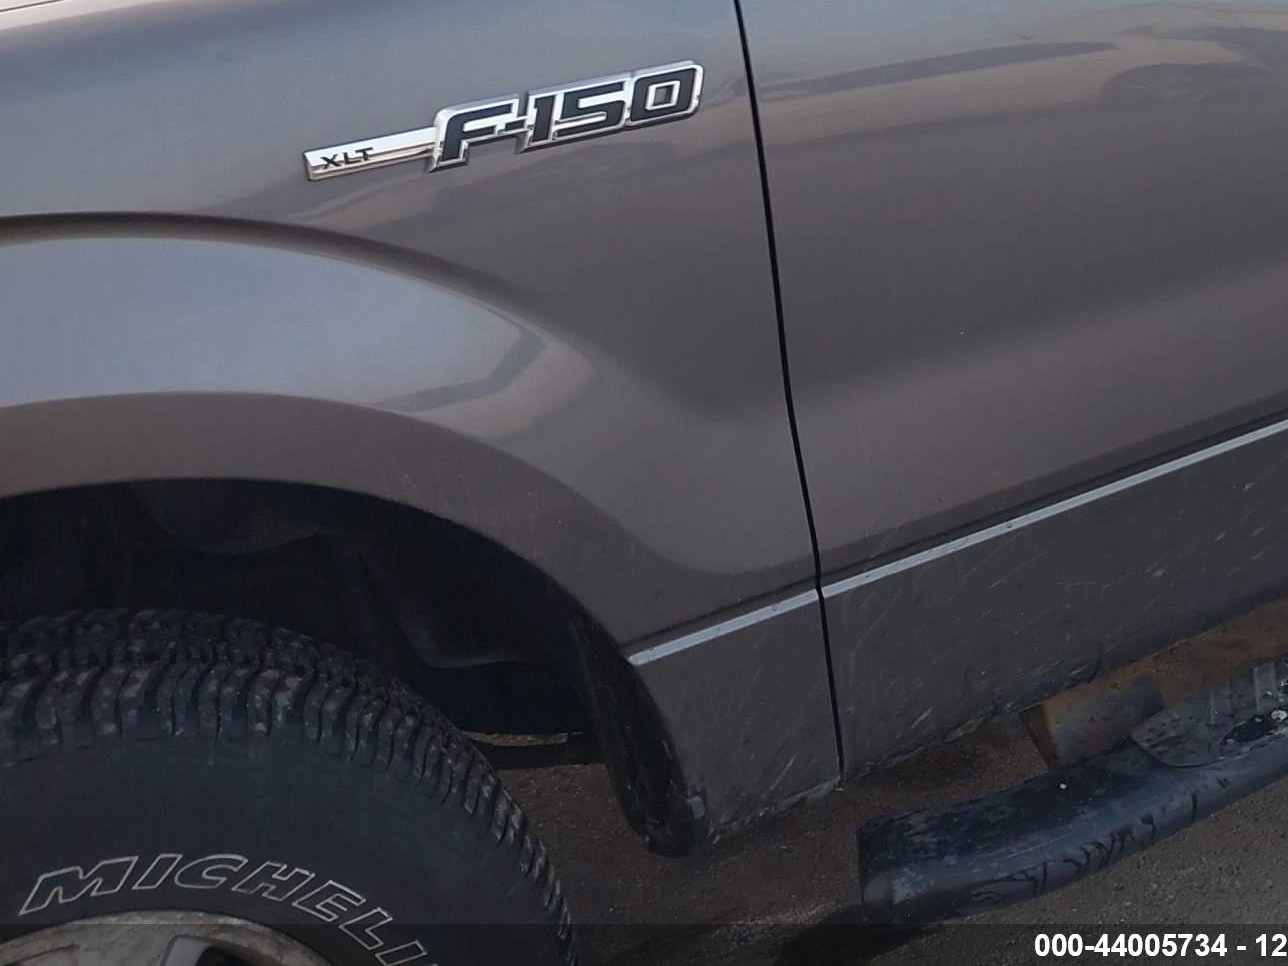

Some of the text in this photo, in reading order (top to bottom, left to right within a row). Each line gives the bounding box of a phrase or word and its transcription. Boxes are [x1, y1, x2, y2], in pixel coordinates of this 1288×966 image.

[320, 61, 704, 172] XLT F-150
[18, 854, 440, 966] MICHELI
